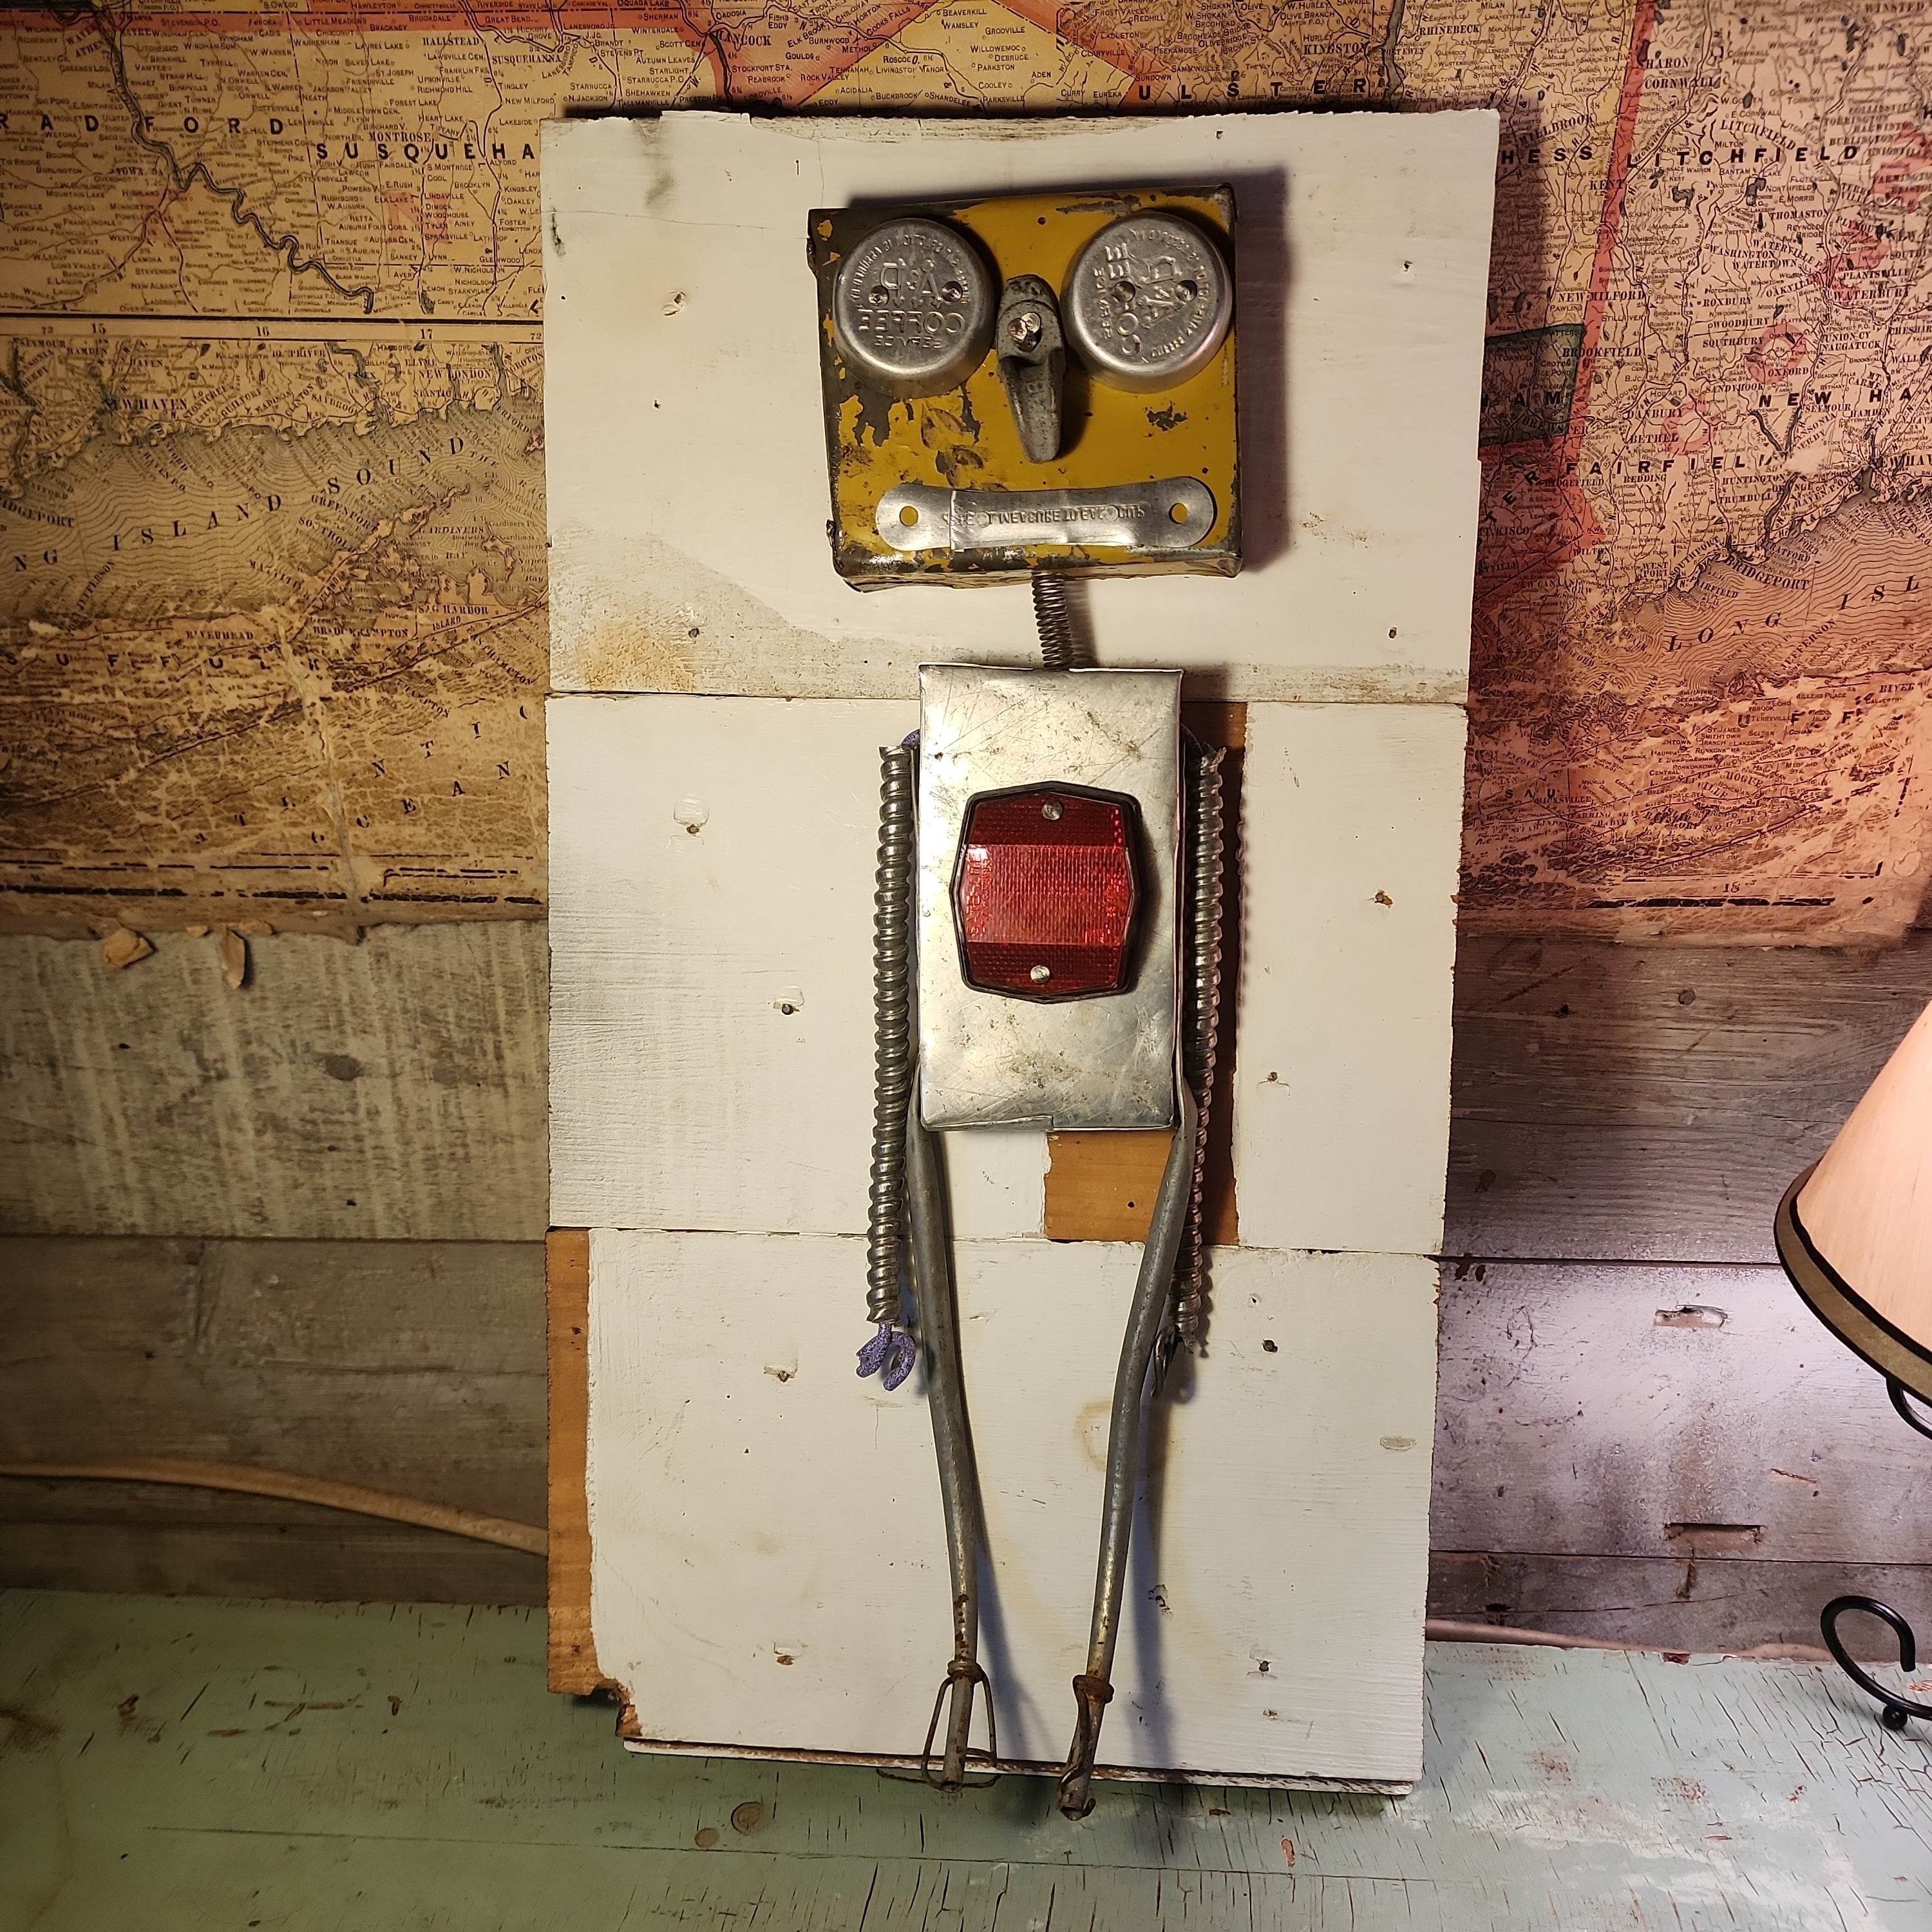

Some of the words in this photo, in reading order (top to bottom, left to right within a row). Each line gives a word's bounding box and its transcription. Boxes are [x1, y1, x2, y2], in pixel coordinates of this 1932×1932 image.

[855, 5, 882, 25] HORTON
[889, 6, 911, 21] FALLS
[1419, 24, 1480, 36] RHINEBECK
[422, 36, 480, 46] HALLSTEAD
[1303, 43, 1367, 55] KINGSTON
[492, 54, 562, 64] SUSQUEHANNA
[562, 43, 578, 77] TAMPICO
[636, 56, 667, 64] AUTUMN
[1171, 64, 1220, 73] SAMSONVILLE
[1139, 77, 1367, 100] ULSTER
[369, 132, 431, 142] MONTROSE
[1721, 118, 1796, 150] LITCHFIELD
[1627, 146, 1859, 169] LITCHFIELD
[1719, 167, 1750, 176] BANTAM
[1765, 184, 1812, 193] NORTHFIELD
[1709, 243, 1775, 258] WASHINGTON
[1732, 258, 1798, 270] WATERTOWN
[1558, 292, 1585, 302] NEW
[1589, 291, 1644, 301] MILFORD
[1702, 296, 1752, 307] ROXBURY
[1712, 317, 1770, 327] WOODBURY
[420, 329, 433, 339] 17
[1702, 337, 1765, 347] SOUTHBURY
[1820, 341, 1882, 352] NAUGATUCK
[1562, 348, 1642, 357] BROOKFIELD
[1768, 367, 1808, 376] OXFORD
[1740, 383, 1763, 392] HOOK
[1627, 408, 1683, 419] DANBURY
[1805, 403, 1851, 413] SEYMOUR
[1630, 433, 1679, 444] BETHEL
[469, 451, 499, 469] THE
[1624, 474, 1667, 483] REDDING
[1722, 474, 1785, 486] HUNTINGTON
[113, 495, 281, 551] ISLAND
[327, 437, 464, 495] SOUND
[1719, 493, 1772, 504] TRUMBULL
[1669, 535, 1719, 578] SOUTHPORT
[1725, 553, 1810, 591] BRIDGEPORT
[1687, 576, 1738, 598] FAIRFIELD
[1667, 612, 1781, 652] LONG
